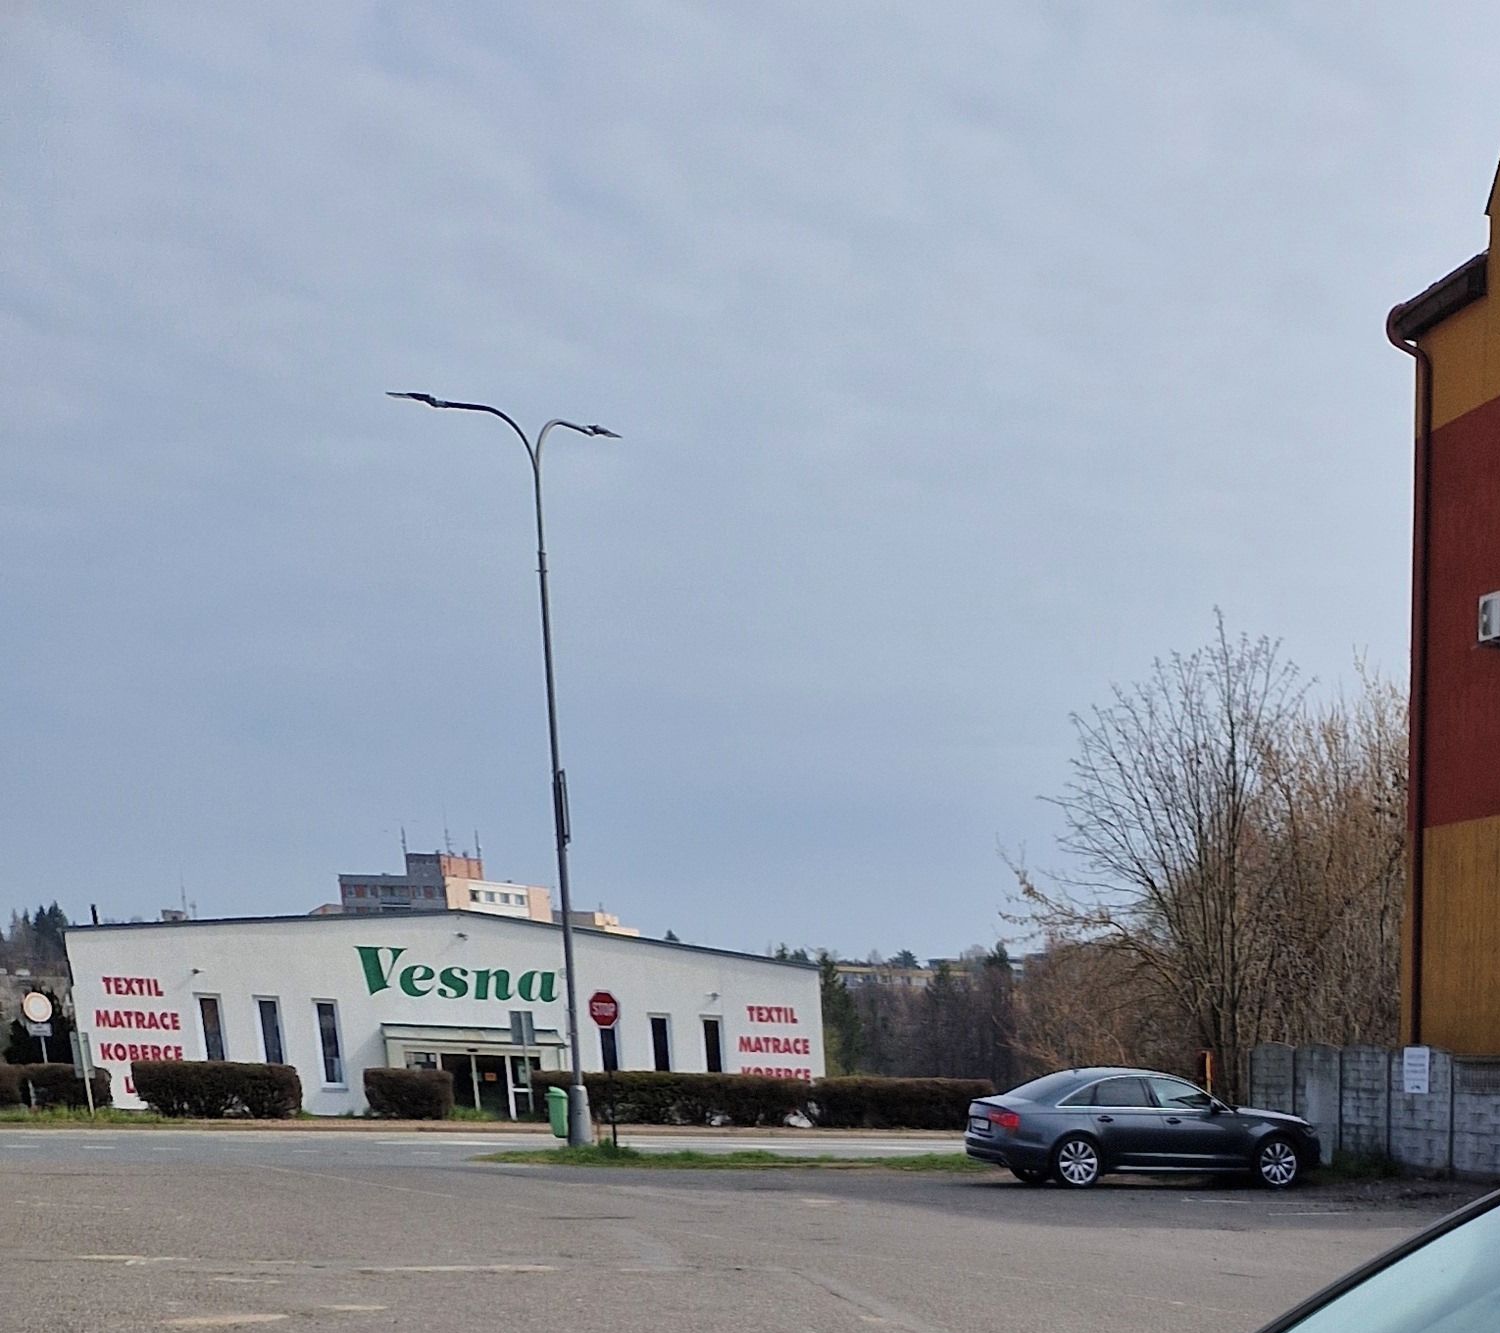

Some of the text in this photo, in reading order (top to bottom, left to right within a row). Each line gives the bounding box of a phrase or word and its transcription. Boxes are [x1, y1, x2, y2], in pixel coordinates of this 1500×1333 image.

[354, 945, 560, 1003] Vesna
[101, 976, 165, 997] TEXTIL
[591, 1002, 616, 1016] STOP
[746, 1005, 799, 1024] TEXTIL
[95, 1009, 182, 1031] MATRACE
[100, 1043, 184, 1062] KOBERCE
[738, 1036, 811, 1055] MATRACE
